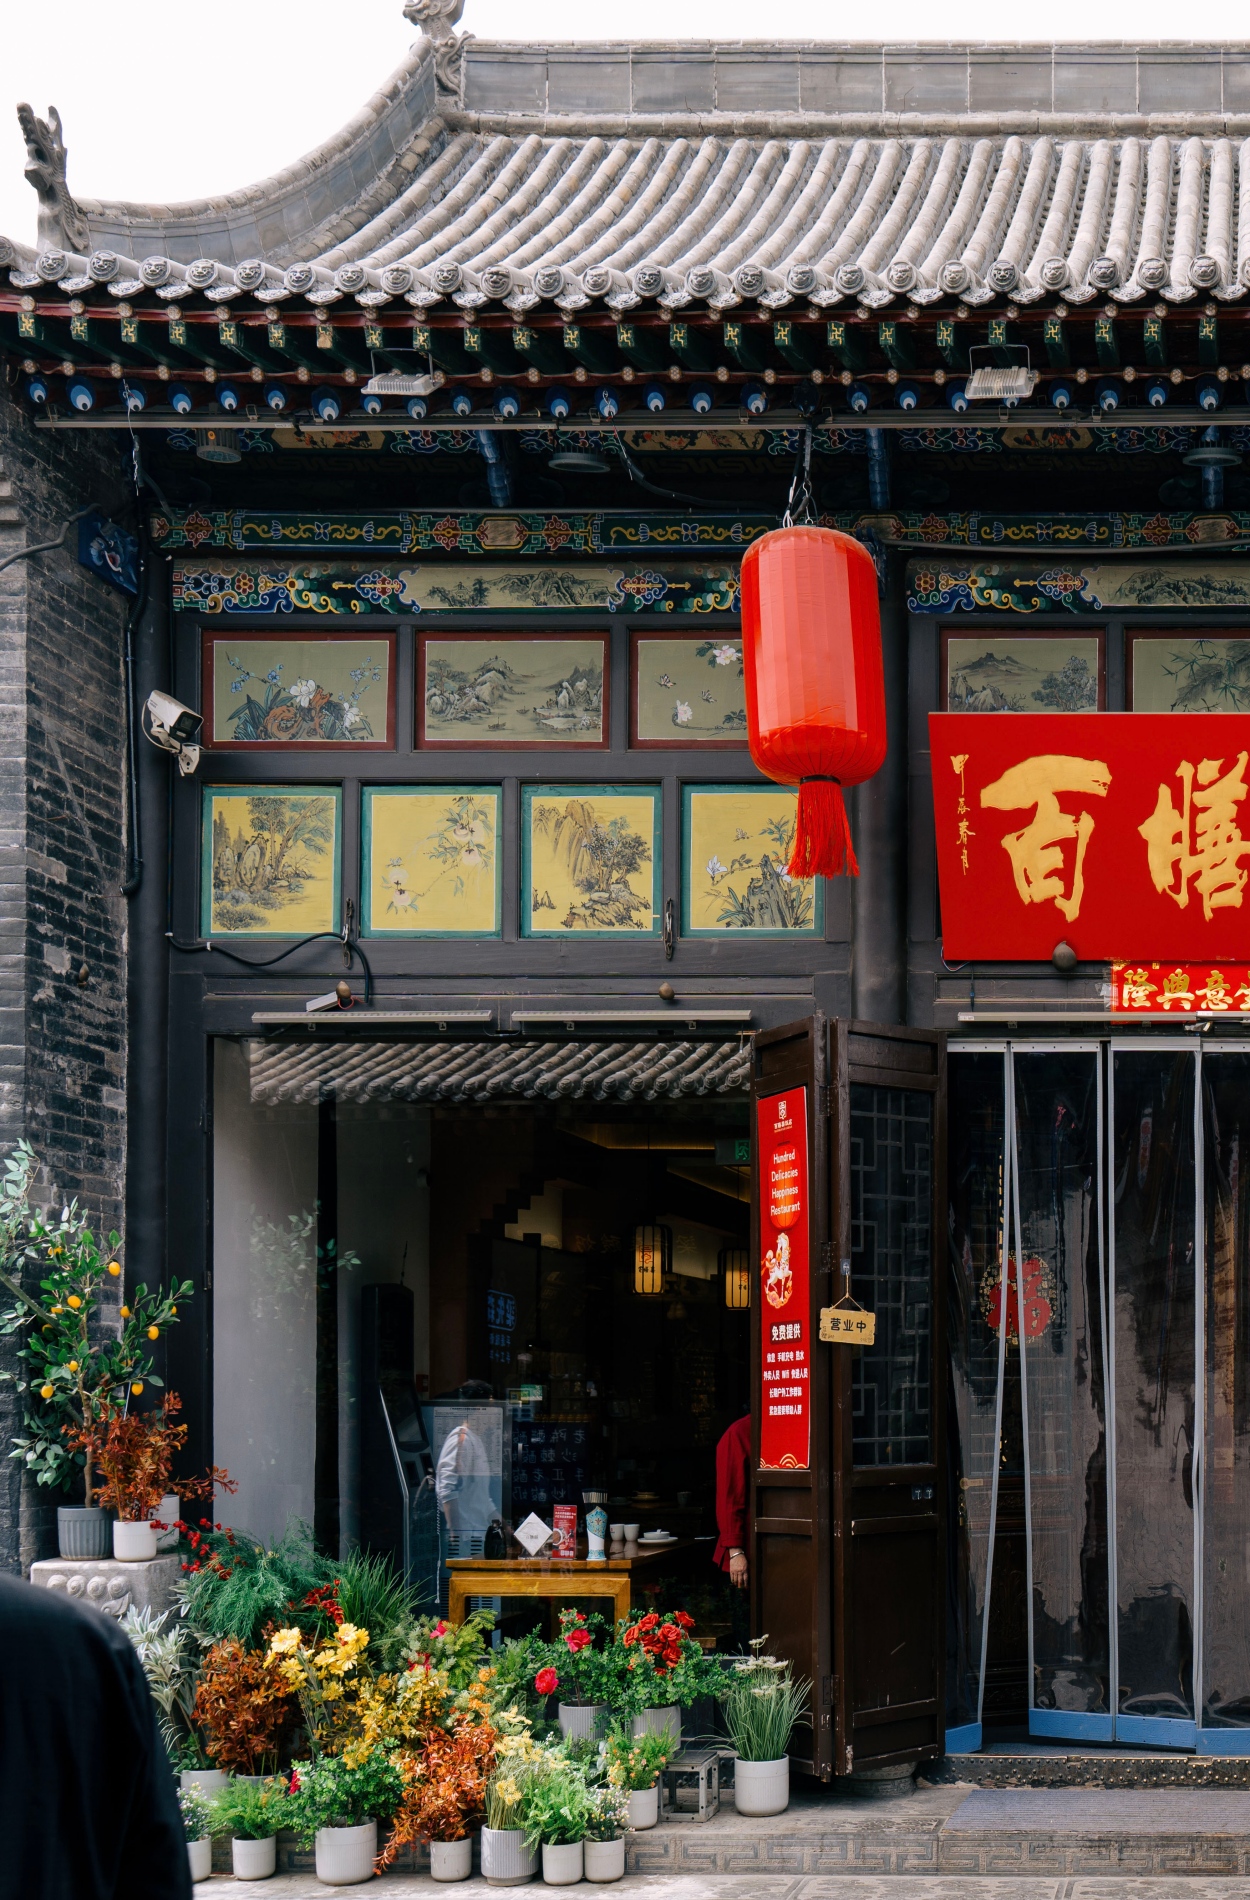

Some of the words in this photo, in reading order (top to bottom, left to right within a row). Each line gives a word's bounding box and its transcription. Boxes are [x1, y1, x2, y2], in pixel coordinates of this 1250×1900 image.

[773, 1149, 795, 1164] Hundred
[771, 1167, 798, 1182] Delicacies
[771, 1185, 798, 1200] Happiness
[770, 1201, 800, 1216] Restaurant
[771, 1323, 801, 1341] 免费提供
[830, 1317, 867, 1333] 营业中
